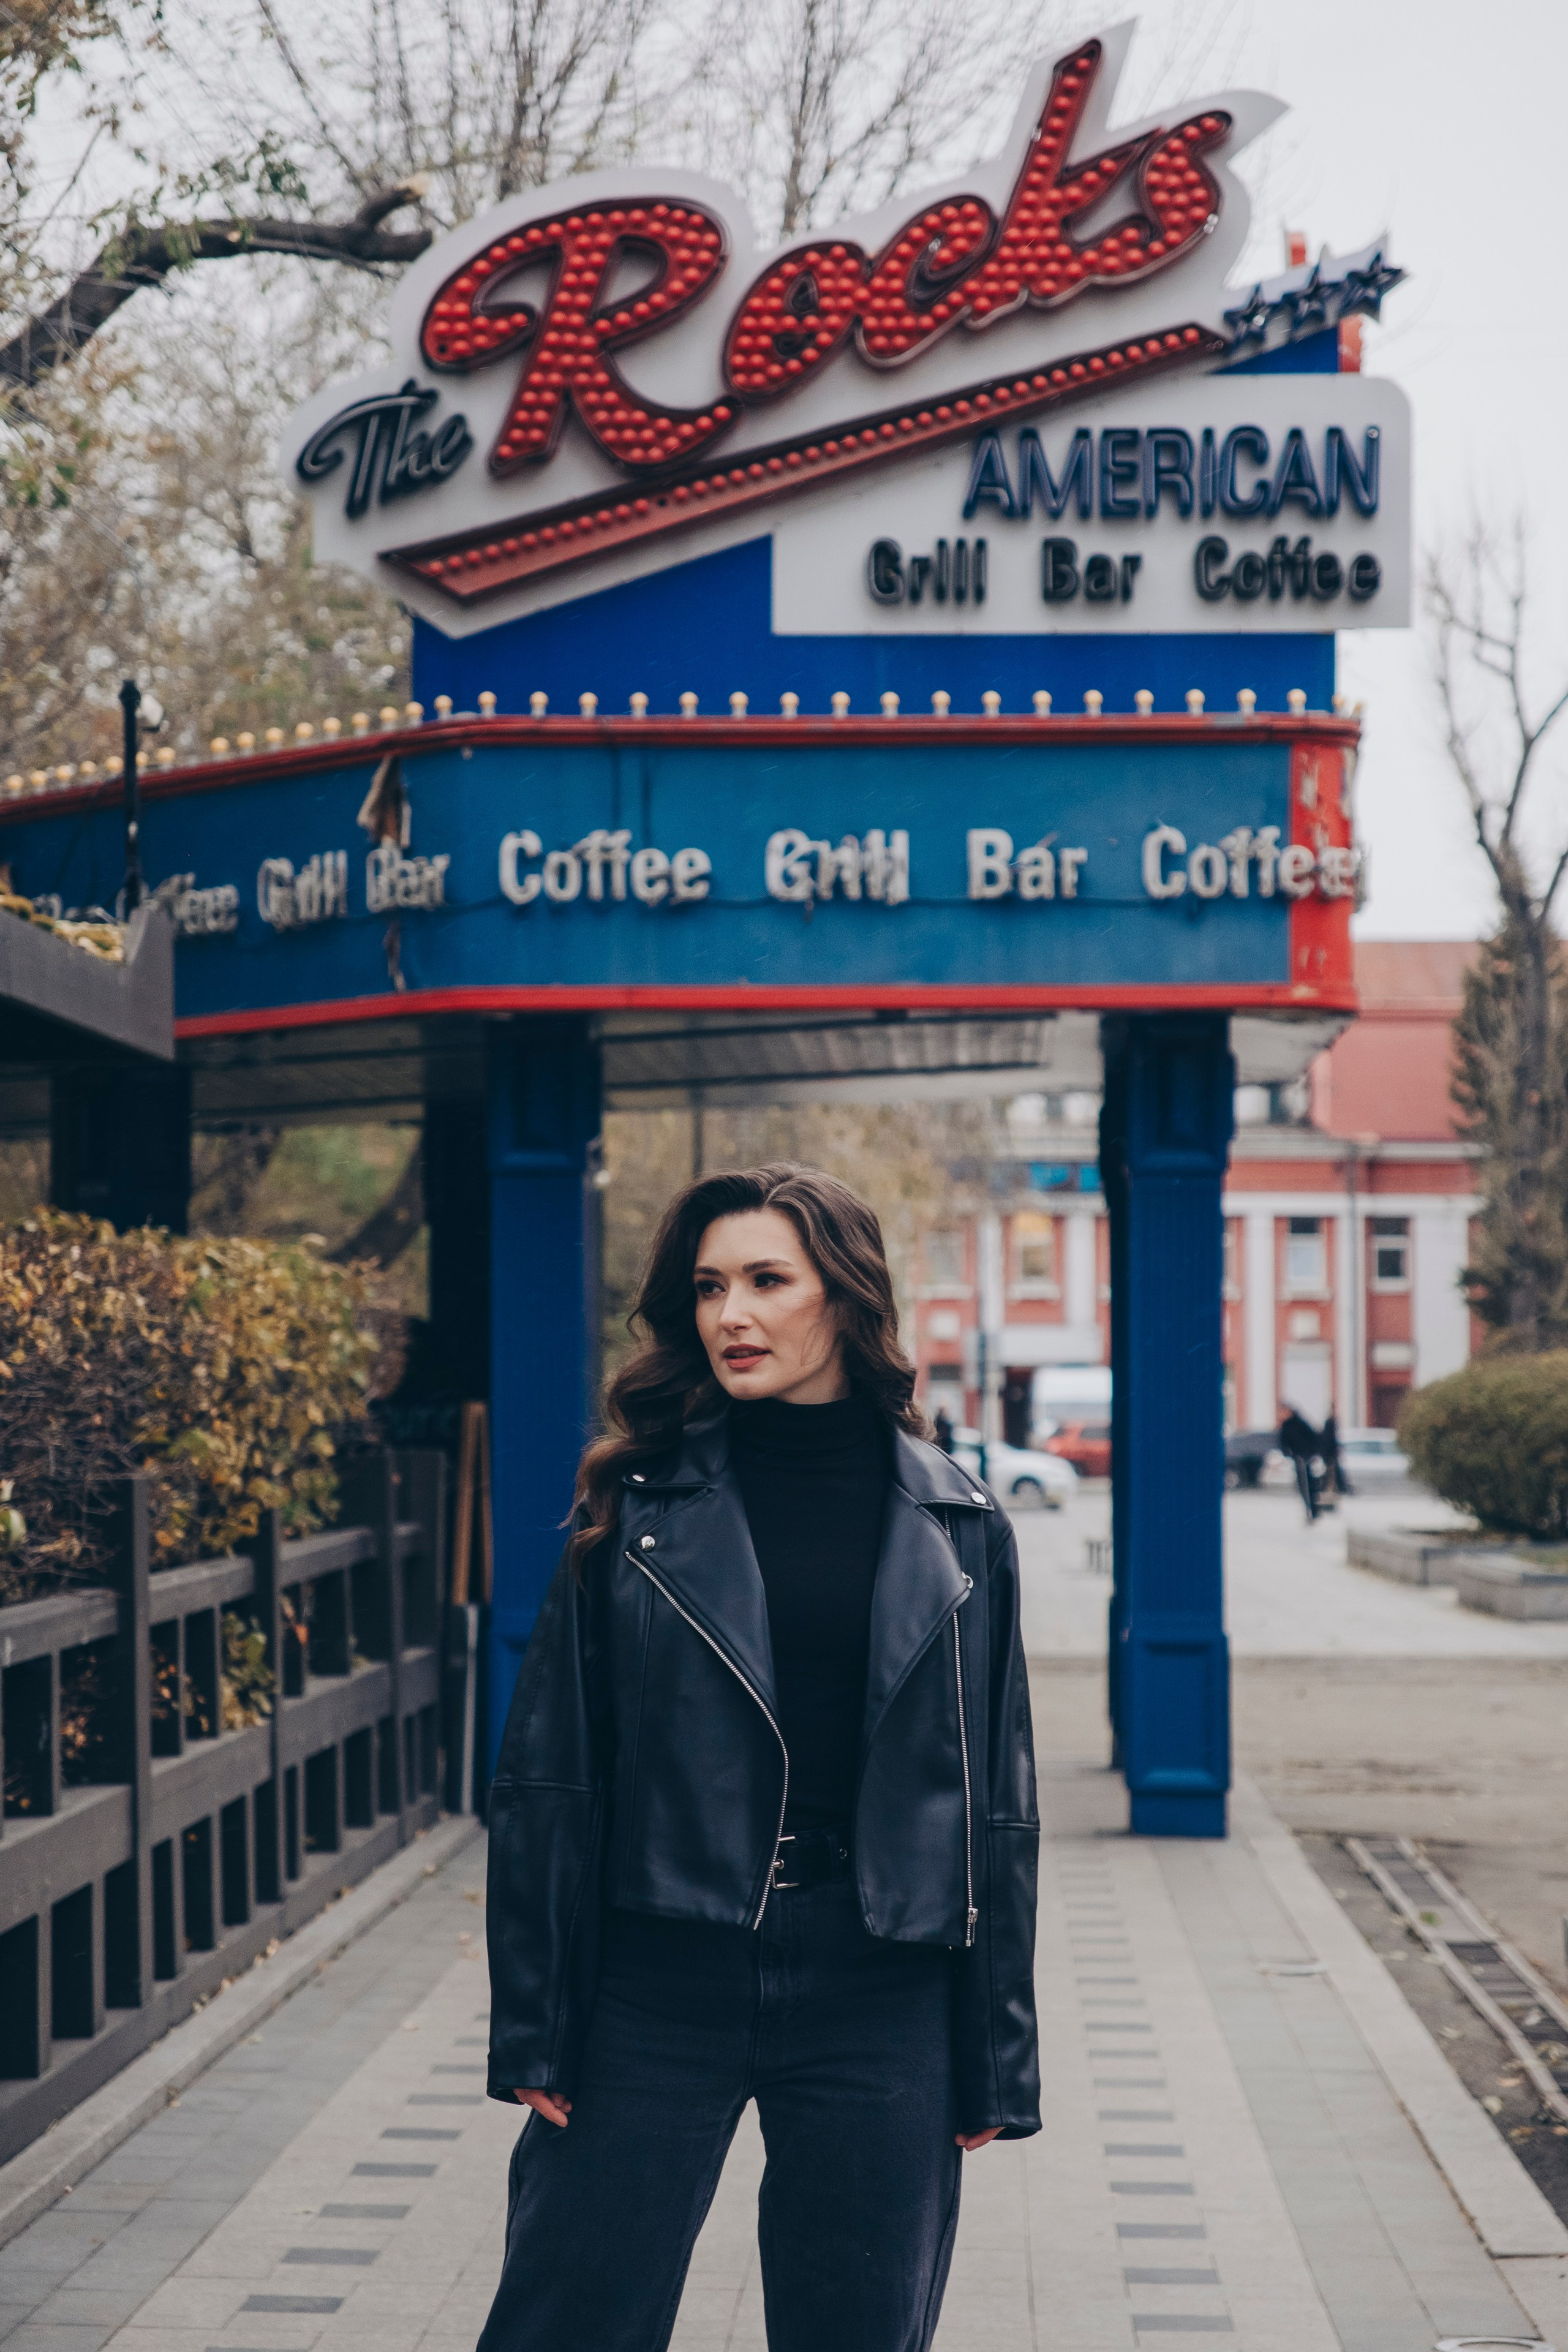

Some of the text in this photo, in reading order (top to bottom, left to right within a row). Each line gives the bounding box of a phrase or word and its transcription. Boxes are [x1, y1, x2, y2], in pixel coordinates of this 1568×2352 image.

[296, 380, 474, 519] The
[963, 426, 1382, 521] AMERICAN
[867, 537, 1383, 606] Grill Bar Coffee
[498, 828, 712, 907] Coffee
[967, 827, 1088, 900] Bar
[1141, 825, 1360, 899] Coffee
